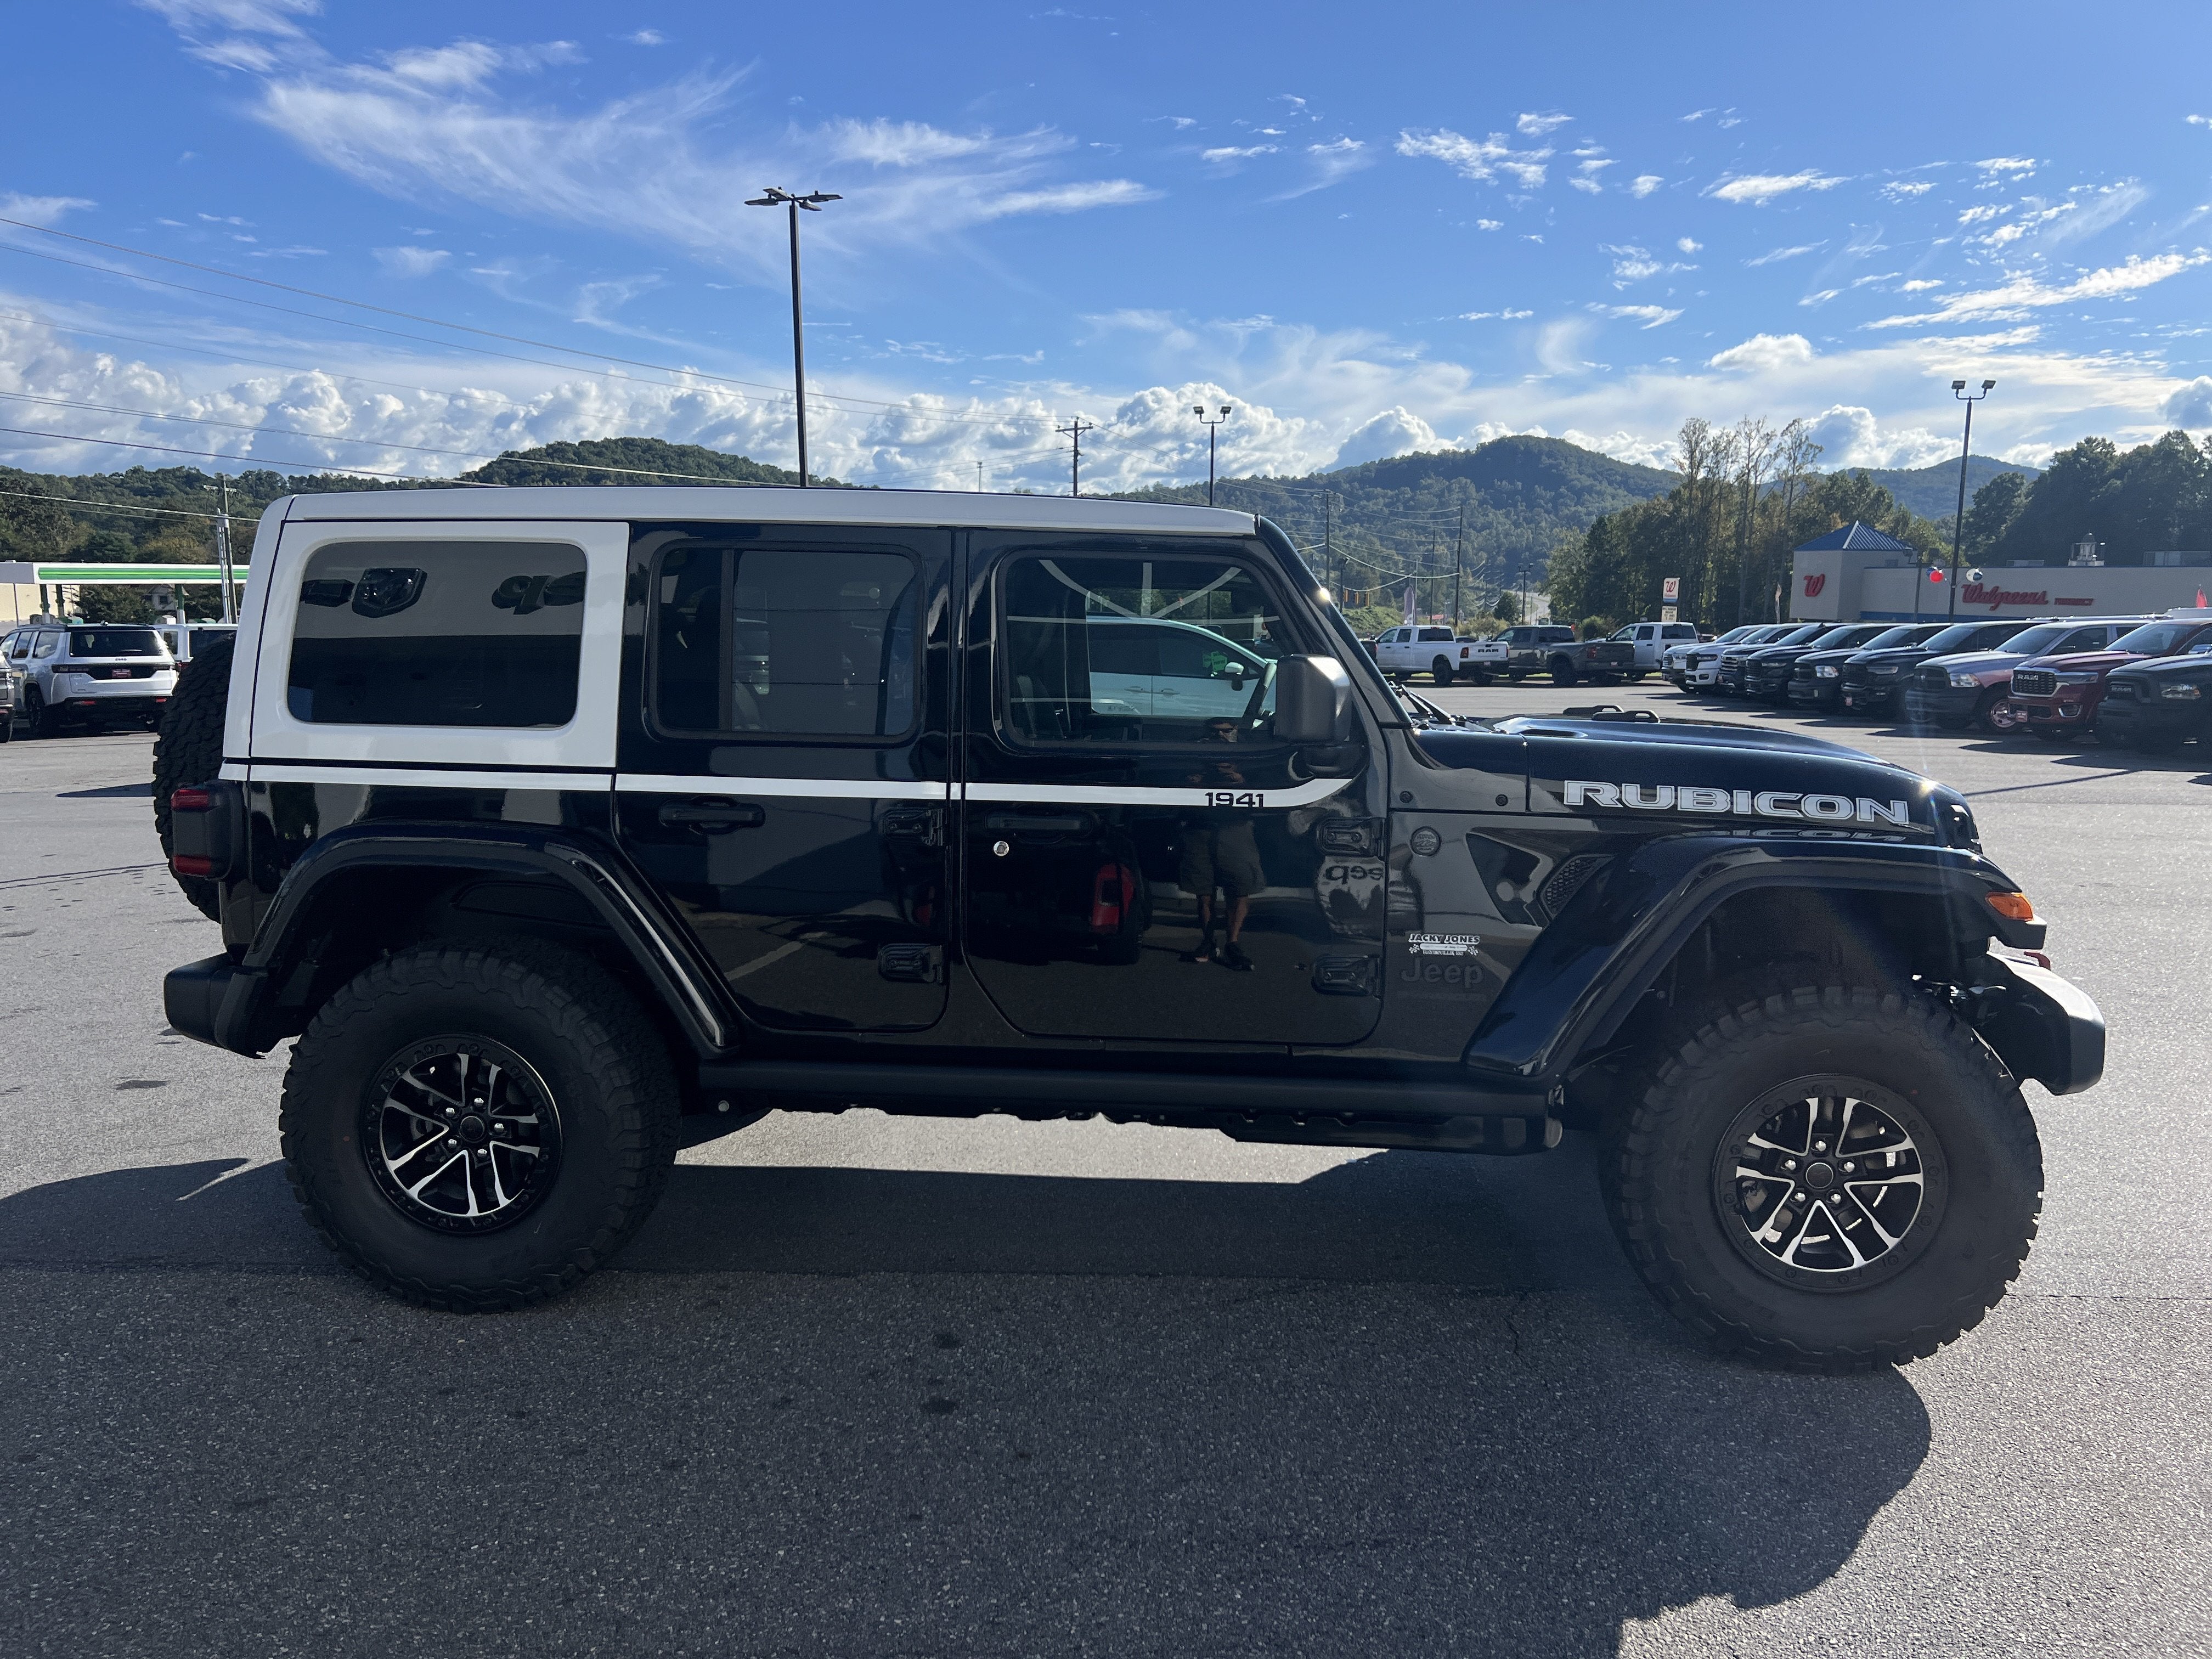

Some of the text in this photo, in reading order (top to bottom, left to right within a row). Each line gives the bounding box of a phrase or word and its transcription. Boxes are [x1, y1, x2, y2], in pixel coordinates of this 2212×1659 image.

[1666, 580, 1676, 592] W
[1803, 574, 1825, 597] W
[1961, 583, 2049, 611] Walgreens
[1205, 792, 1264, 807] 1941
[1564, 780, 1909, 823] RUBICON
[1409, 934, 1480, 944] JACKY JONES
[1401, 957, 1484, 988] Jeep
